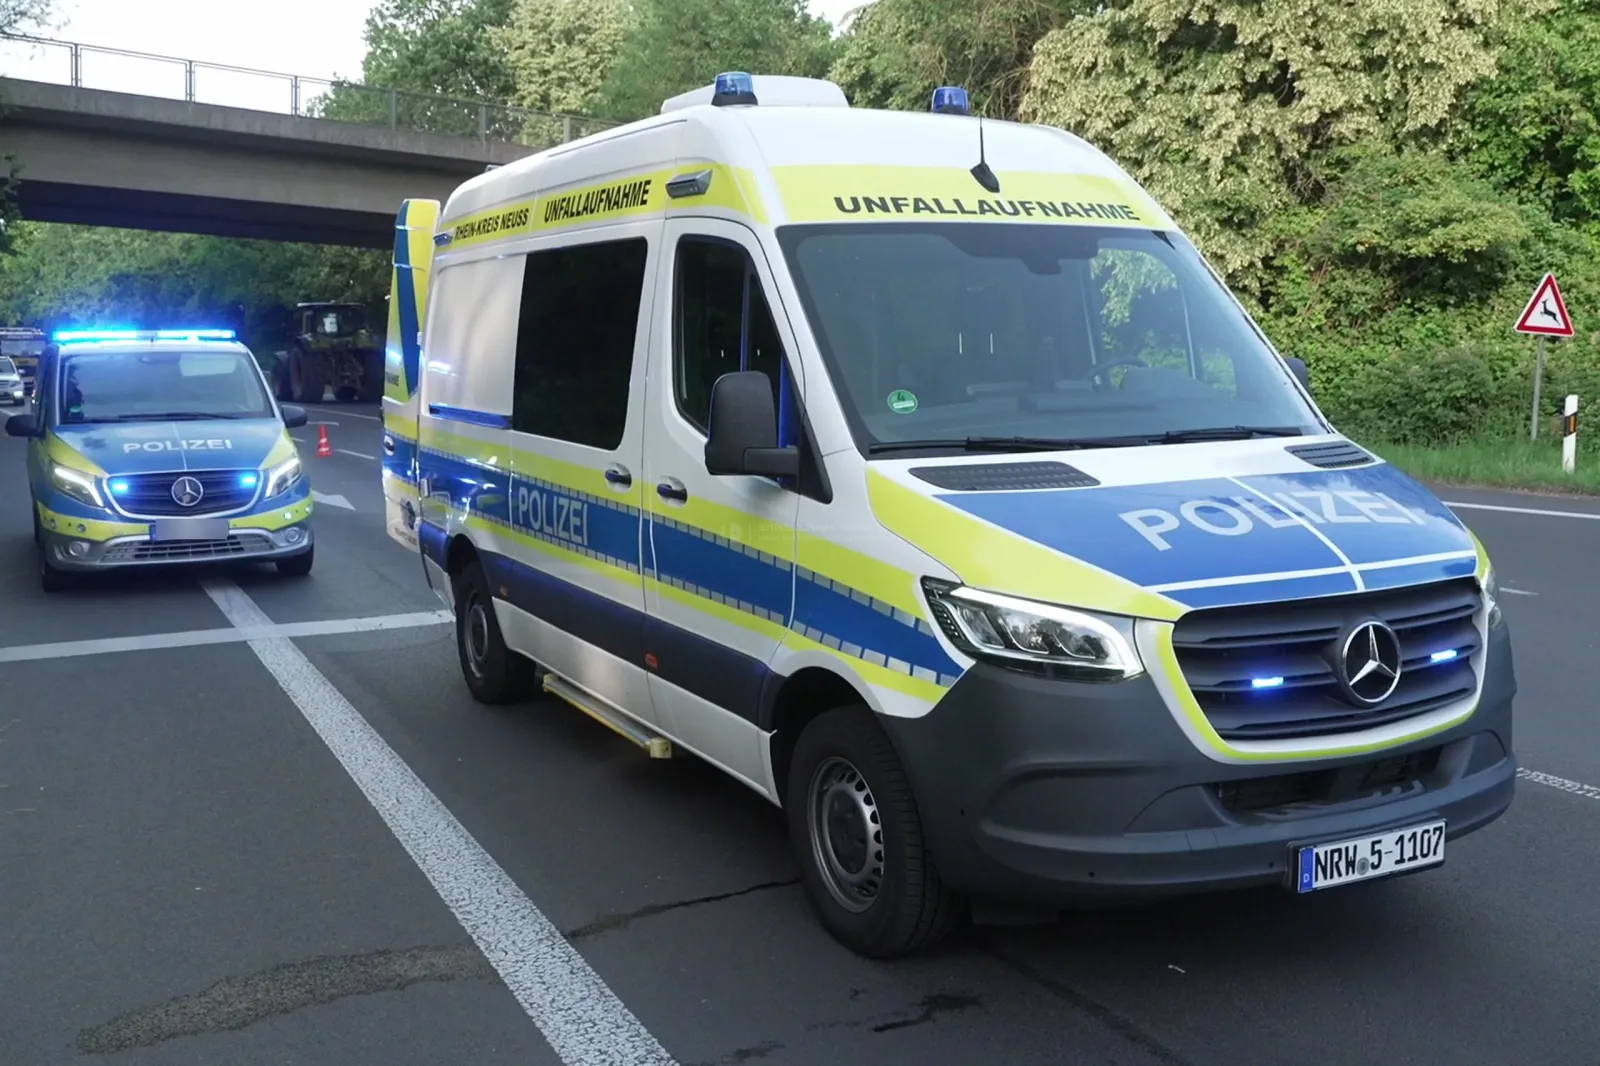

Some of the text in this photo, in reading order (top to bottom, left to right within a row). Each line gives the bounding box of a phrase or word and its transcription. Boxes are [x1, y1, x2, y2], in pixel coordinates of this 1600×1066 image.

[544, 179, 652, 224] UNFALLAUFNAHME
[833, 196, 1141, 221] UNFALLAUFNAHME
[454, 208, 529, 241] RHEIN-KREIS NEUSS
[123, 439, 233, 455] POLIZEI
[518, 486, 588, 546] POLIZEI
[1119, 490, 1426, 551] POLIZEI
[1314, 825, 1444, 882] NRW 5-1107
